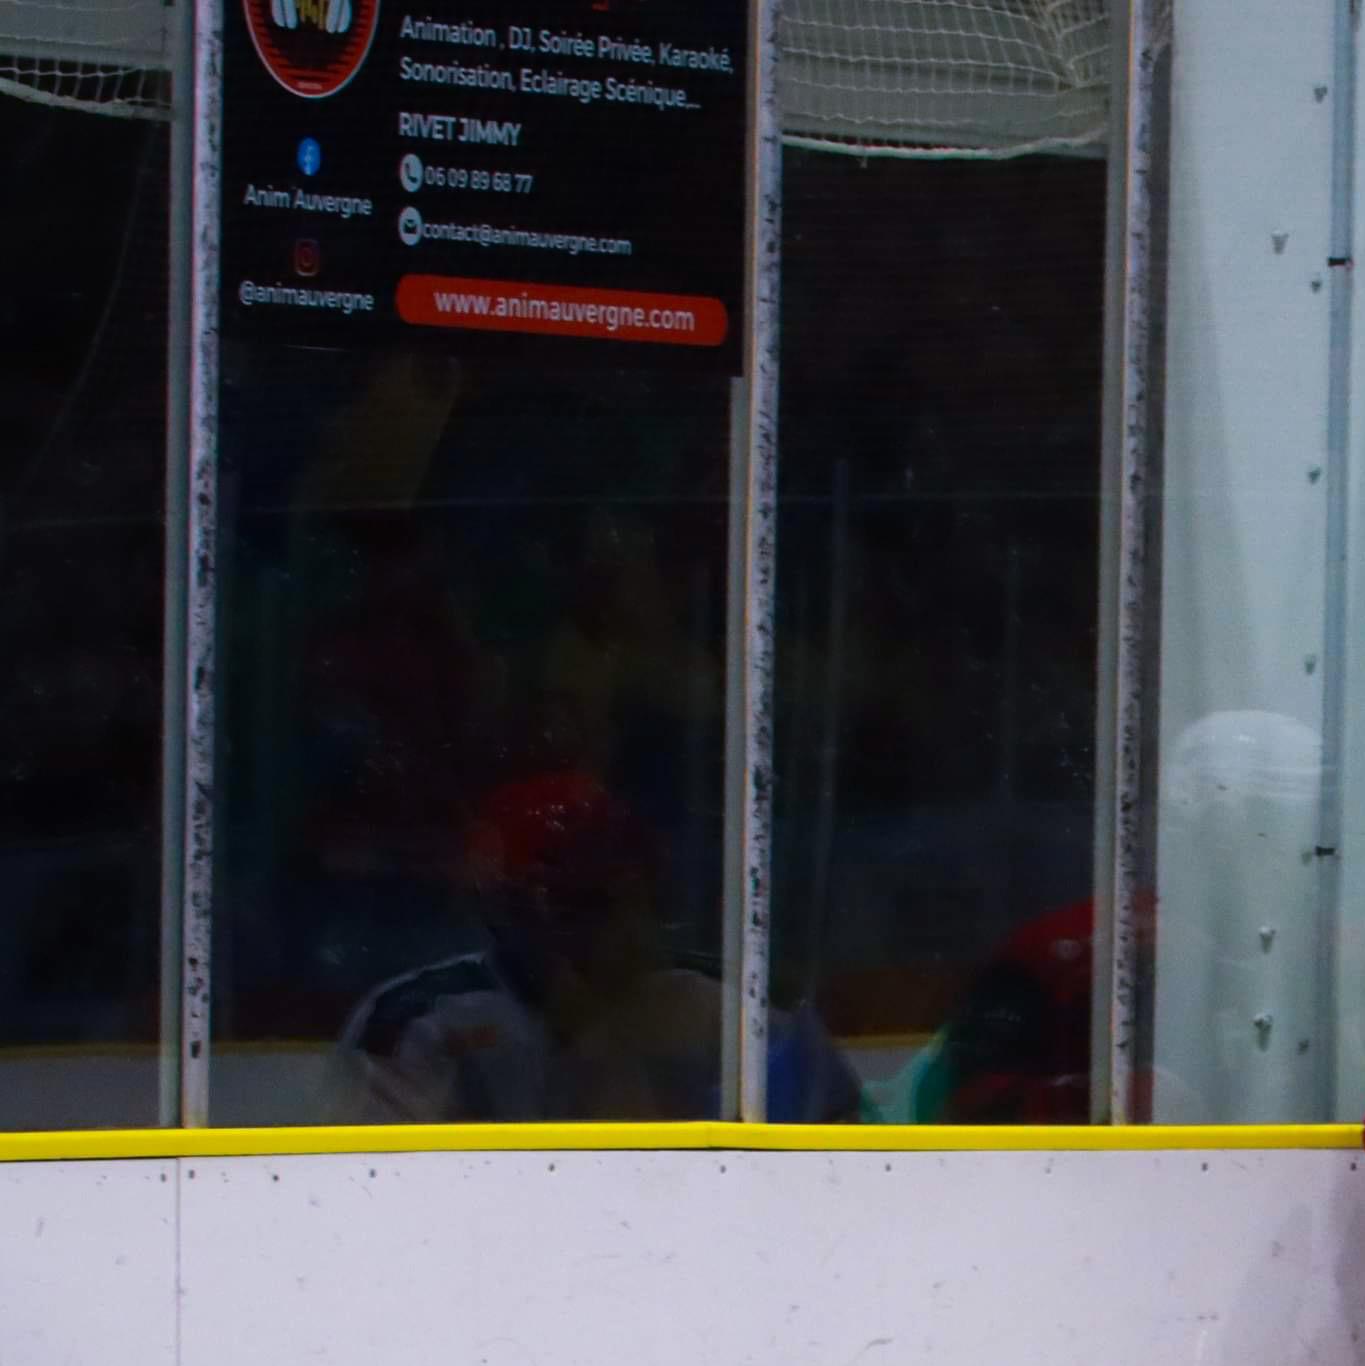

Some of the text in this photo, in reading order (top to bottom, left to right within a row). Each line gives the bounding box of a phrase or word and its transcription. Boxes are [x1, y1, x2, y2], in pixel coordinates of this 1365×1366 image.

[401, 15, 496, 47] Animation
[538, 29, 595, 57] Soirée
[400, 57, 516, 93] Sonorisation,
[520, 68, 601, 103] Eclairage
[399, 112, 522, 146] RIVET JIMMY
[426, 166, 446, 186] 06
[447, 168, 468, 188] 09
[470, 170, 490, 190] 89
[514, 174, 534, 194] 77
[423, 222, 632, 254] contact@animauvergne.com
[239, 280, 375, 314] @animauvergne
[433, 292, 695, 331] www.animauvergne.com
